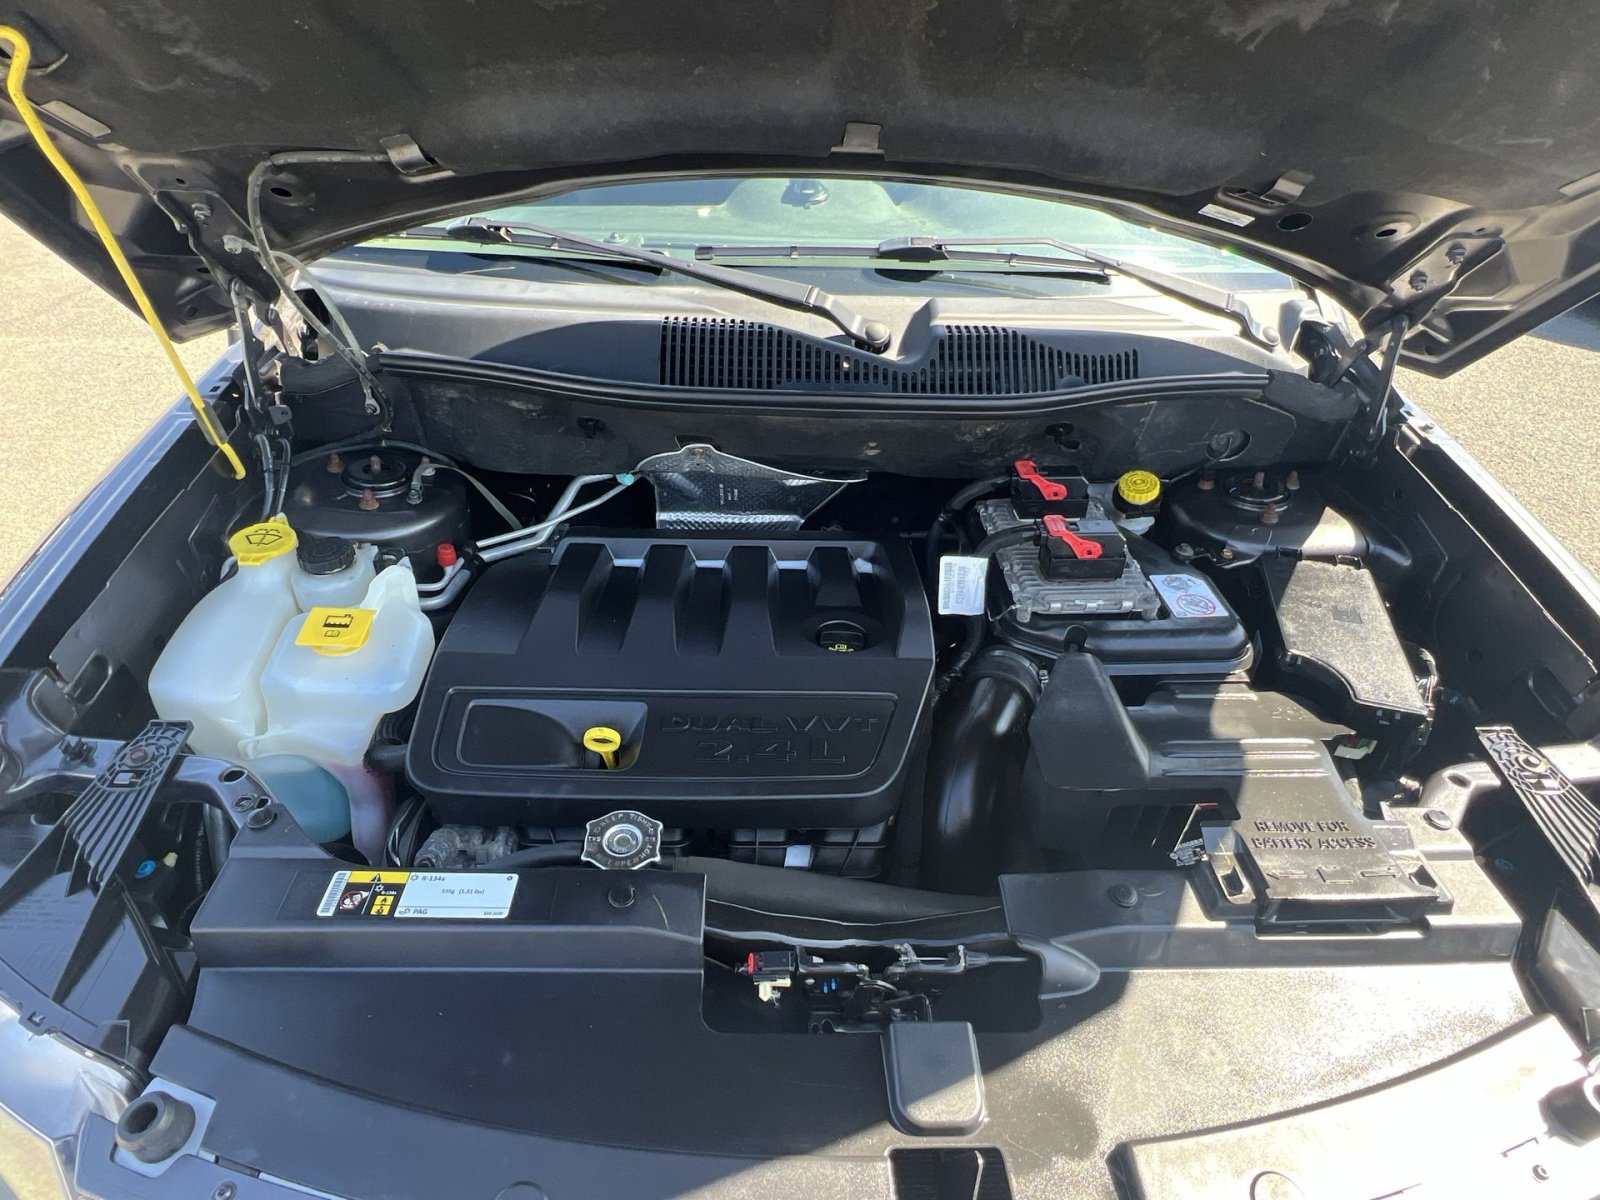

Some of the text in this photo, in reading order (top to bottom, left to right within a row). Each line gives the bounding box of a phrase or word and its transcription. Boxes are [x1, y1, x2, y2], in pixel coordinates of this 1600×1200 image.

[661, 714, 879, 733] DUAL VVT
[697, 740, 845, 763] 2.4L
[1253, 820, 1350, 834] REMOVE FOR
[1251, 836, 1378, 850] BATTERY ACCESS
[421, 874, 446, 882] R-134a
